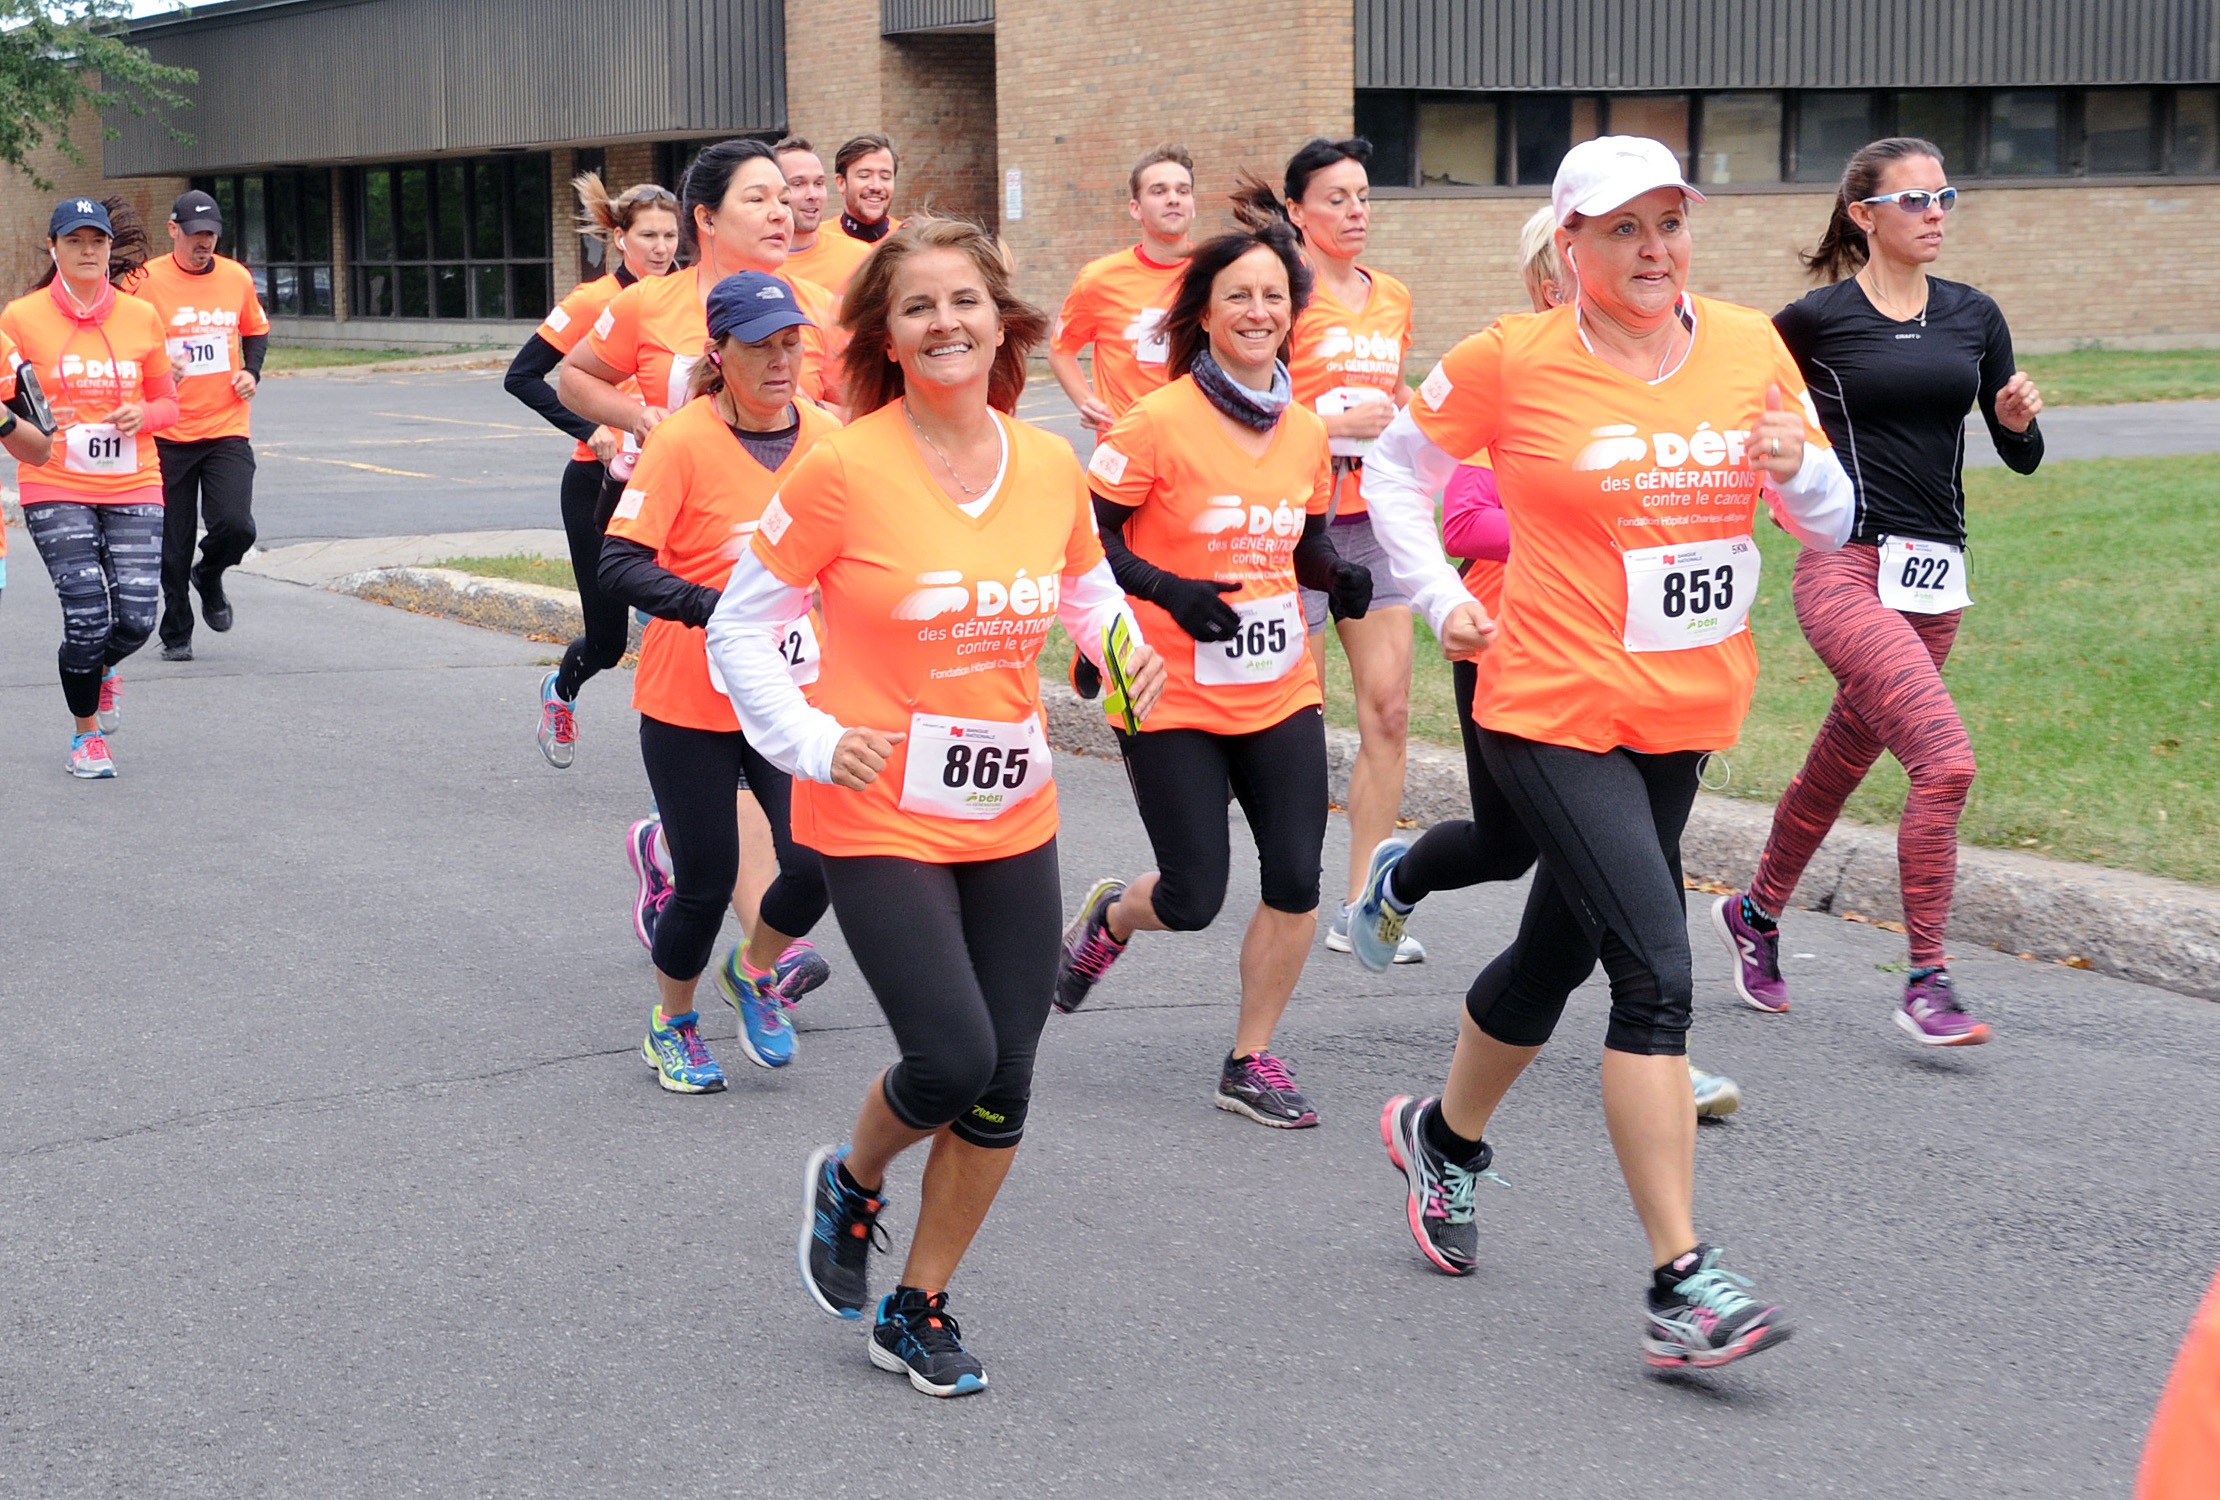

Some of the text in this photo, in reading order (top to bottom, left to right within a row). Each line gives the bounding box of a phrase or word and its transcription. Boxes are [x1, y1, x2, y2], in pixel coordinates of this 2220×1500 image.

[88, 436, 121, 458] 611
[1600, 468, 1756, 493] des GÉNÉRATIONS
[1643, 492, 1691, 507] contre
[1695, 490, 1710, 505] le
[1207, 539, 1228, 552] des
[1231, 552, 1268, 567] contre
[1900, 556, 1950, 591] 622
[1663, 564, 1734, 618] 853
[918, 627, 948, 642] des
[956, 638, 1001, 656] contre
[1004, 637, 1018, 651] le
[943, 744, 1030, 790] 865
[971, 1104, 1005, 1124] ZUMBA
